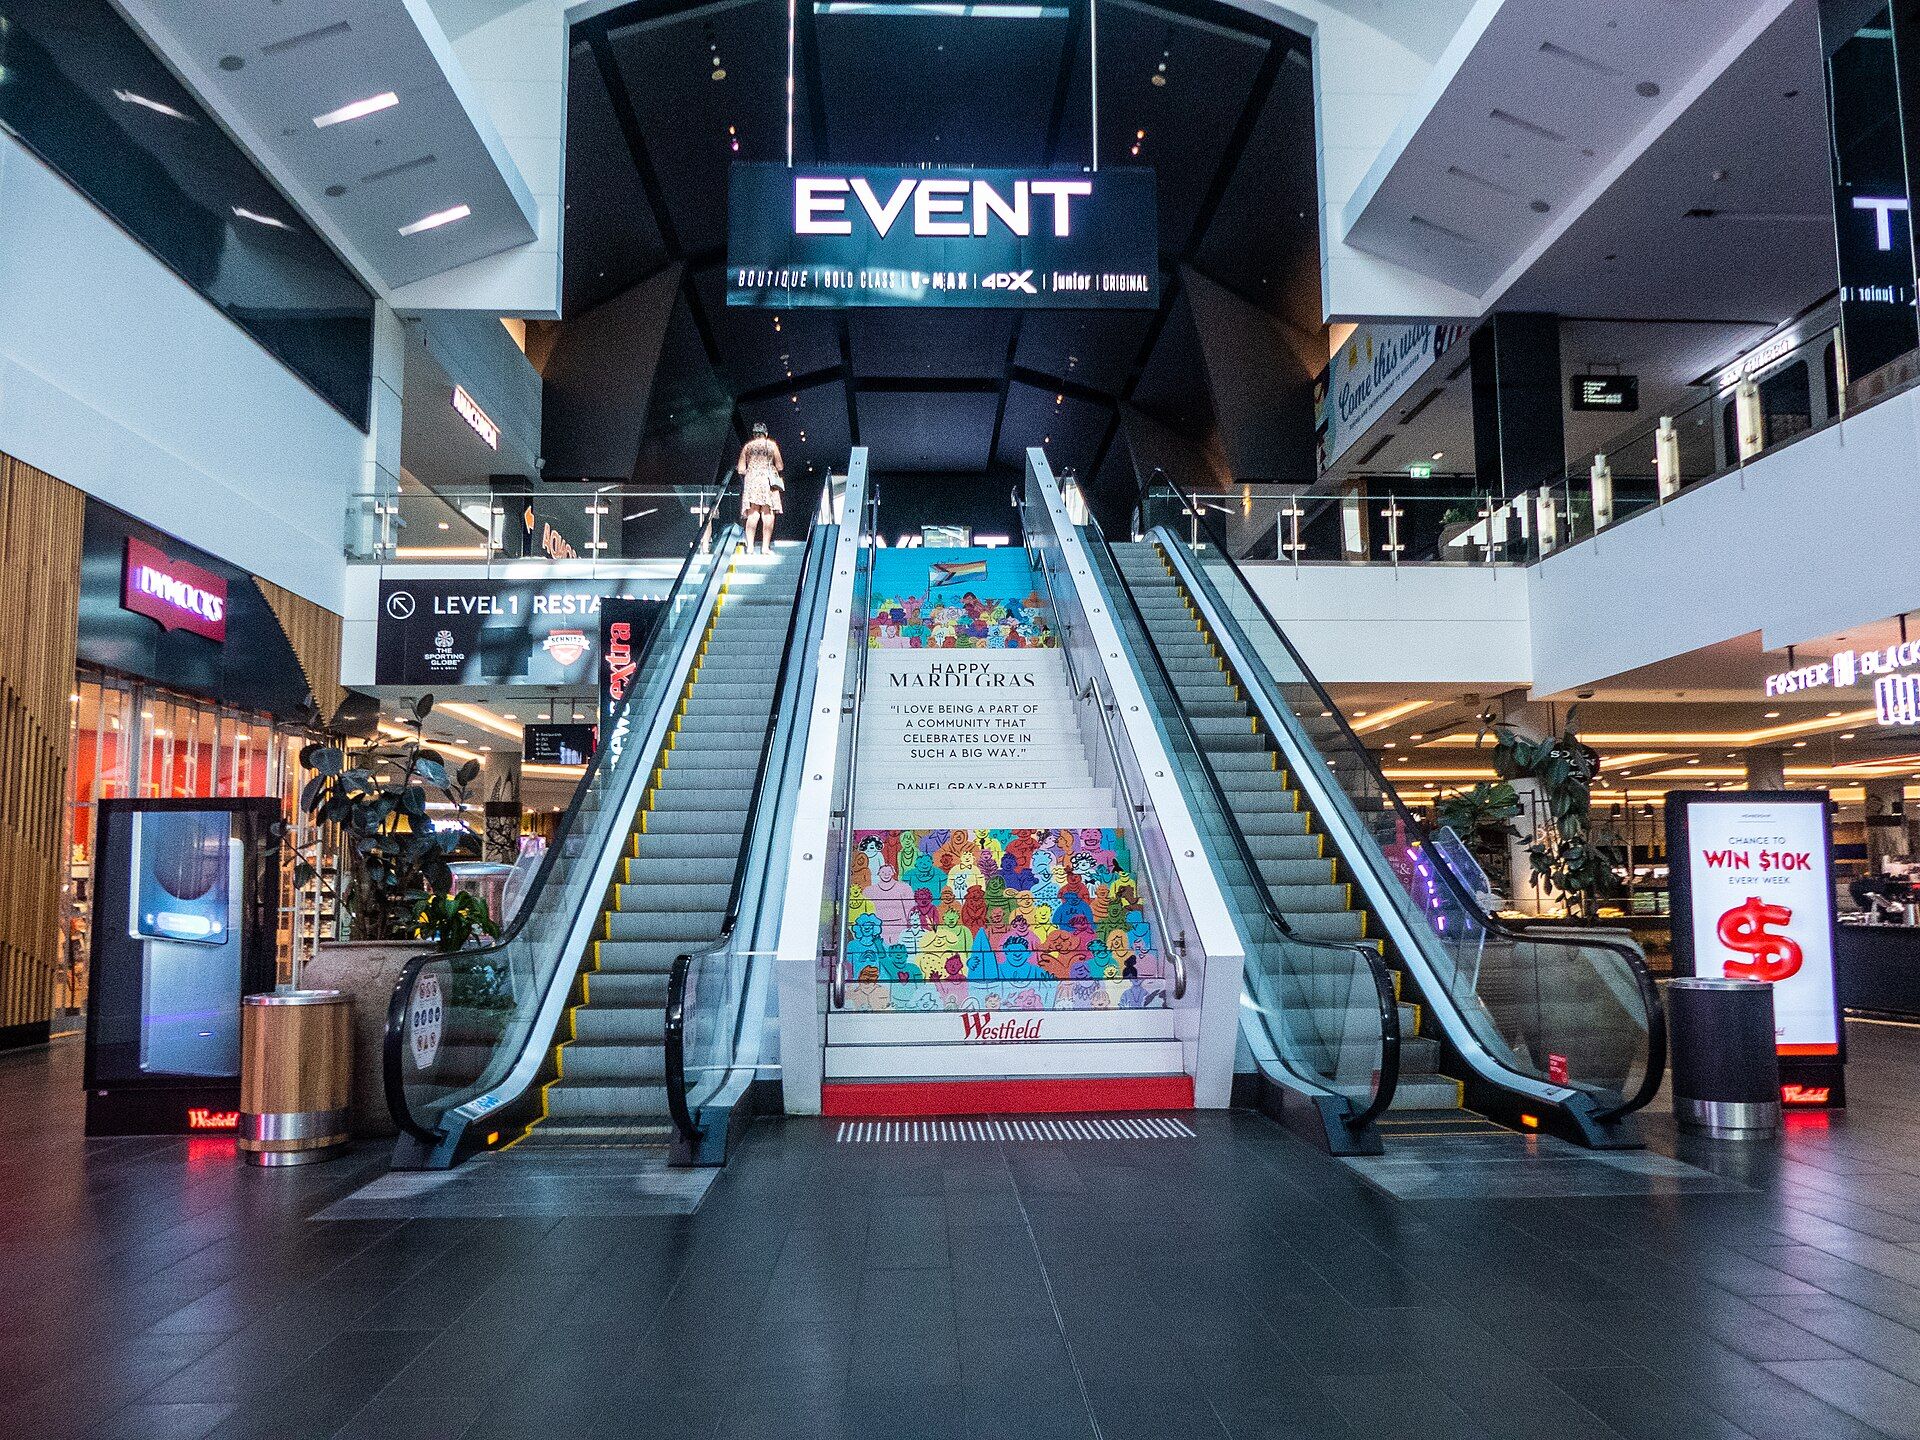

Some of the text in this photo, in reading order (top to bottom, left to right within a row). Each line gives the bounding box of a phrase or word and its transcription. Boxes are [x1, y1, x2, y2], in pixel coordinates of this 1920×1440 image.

[795, 178, 1092, 238] EVENT
[738, 270, 808, 288] BOUTIQUE
[860, 271, 896, 289] CLASS
[981, 269, 1038, 294] 4DX
[1052, 271, 1092, 293] junior
[1102, 273, 1149, 292] ORIGINAL
[1338, 382, 1372, 422] Come
[1373, 339, 1398, 388] this
[141, 565, 224, 622] DYMOCKS
[434, 595, 504, 615] LEVEL
[508, 595, 518, 615] 1
[550, 635, 582, 643] SCHNITZ
[1860, 638, 1920, 676] BLACK
[931, 663, 990, 674] HAPPY
[890, 673, 1035, 687] MARDI GRAS
[1765, 662, 1830, 697] FOSTER
[904, 705, 934, 714] LOVE
[938, 705, 974, 714] BEING
[977, 705, 986, 714] A
[989, 705, 1019, 714] PART
[1022, 704, 1039, 714] OF
[905, 718, 1027, 728] A COMMUNITY THAT
[903, 733, 1032, 743] CELEBRATES LOVE IN
[910, 749, 945, 759] SUCH
[949, 749, 958, 758] A
[962, 748, 983, 758] BIG
[947, 781, 1047, 789] GRAY-BARNETT
[1728, 836, 1787, 845] CHANCE TO
[1702, 849, 1811, 872] WIN $10K
[1728, 876, 1791, 885] EVERY WEEK
[960, 1012, 1044, 1040] Westfield
[187, 1108, 241, 1129] Westfield
